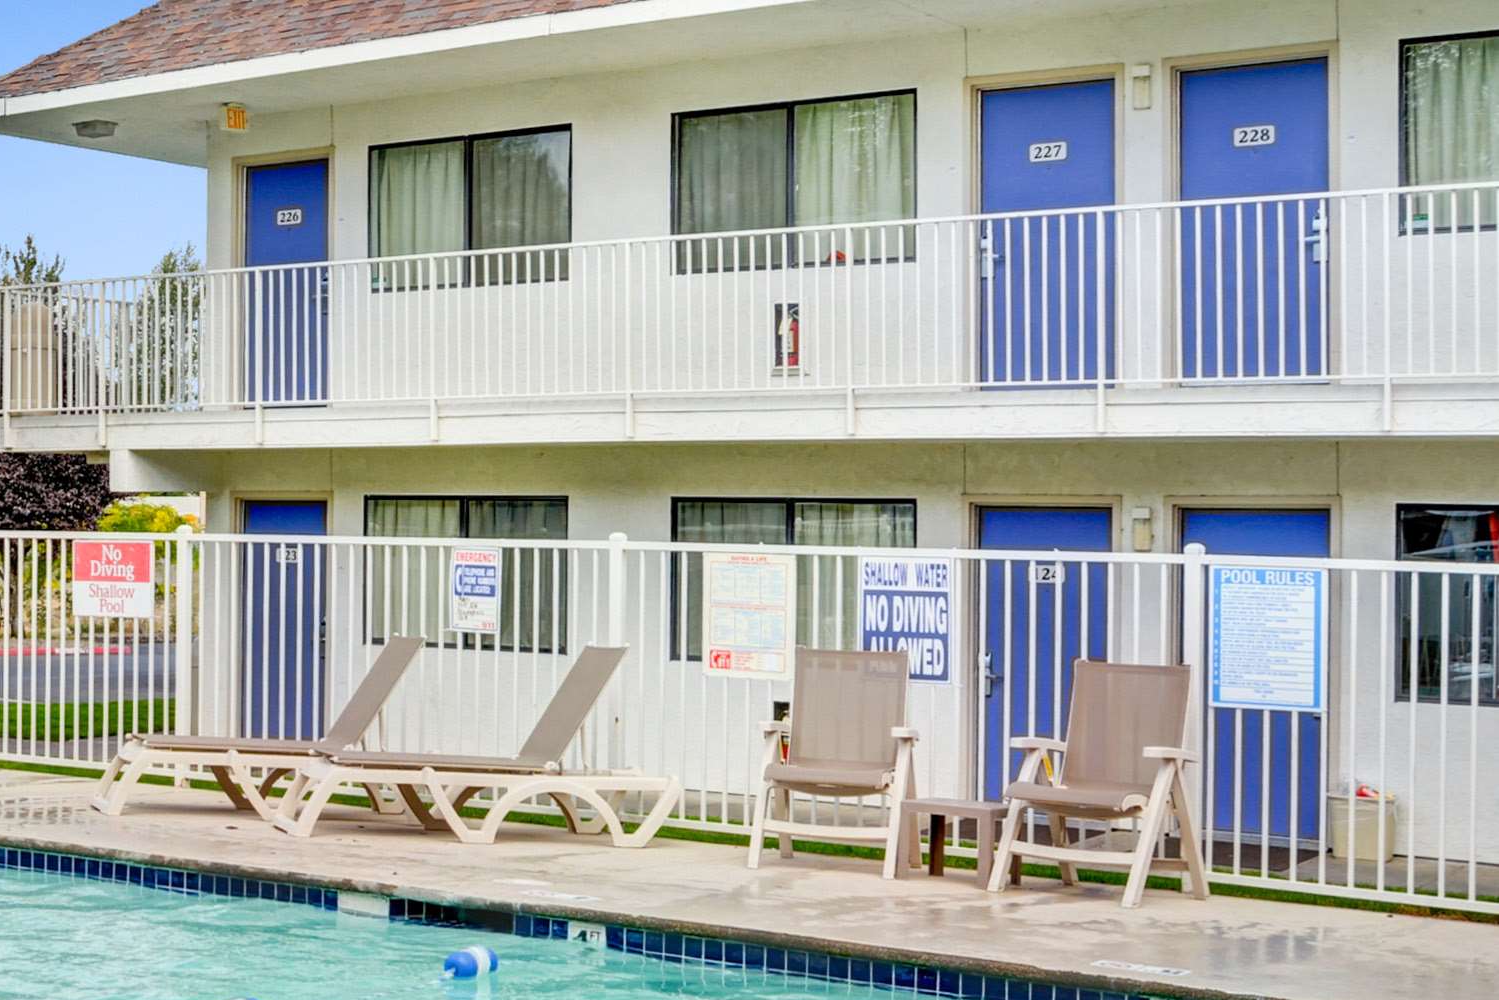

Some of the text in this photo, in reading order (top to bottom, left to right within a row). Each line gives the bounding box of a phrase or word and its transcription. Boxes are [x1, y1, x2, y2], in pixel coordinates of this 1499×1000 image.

[1239, 128, 1270, 143] 228
[1034, 144, 1062, 159] 227
[280, 211, 299, 223] 226
[102, 544, 122, 561] No
[455, 552, 496, 563] EMERGENCY
[90, 560, 135, 581] Diving
[864, 562, 948, 588] SHALLOW WATER
[1221, 569, 1315, 586] POOL RULES
[89, 584, 134, 598] Shallow
[100, 599, 124, 613] Pool
[865, 594, 948, 635] NO DIVING
